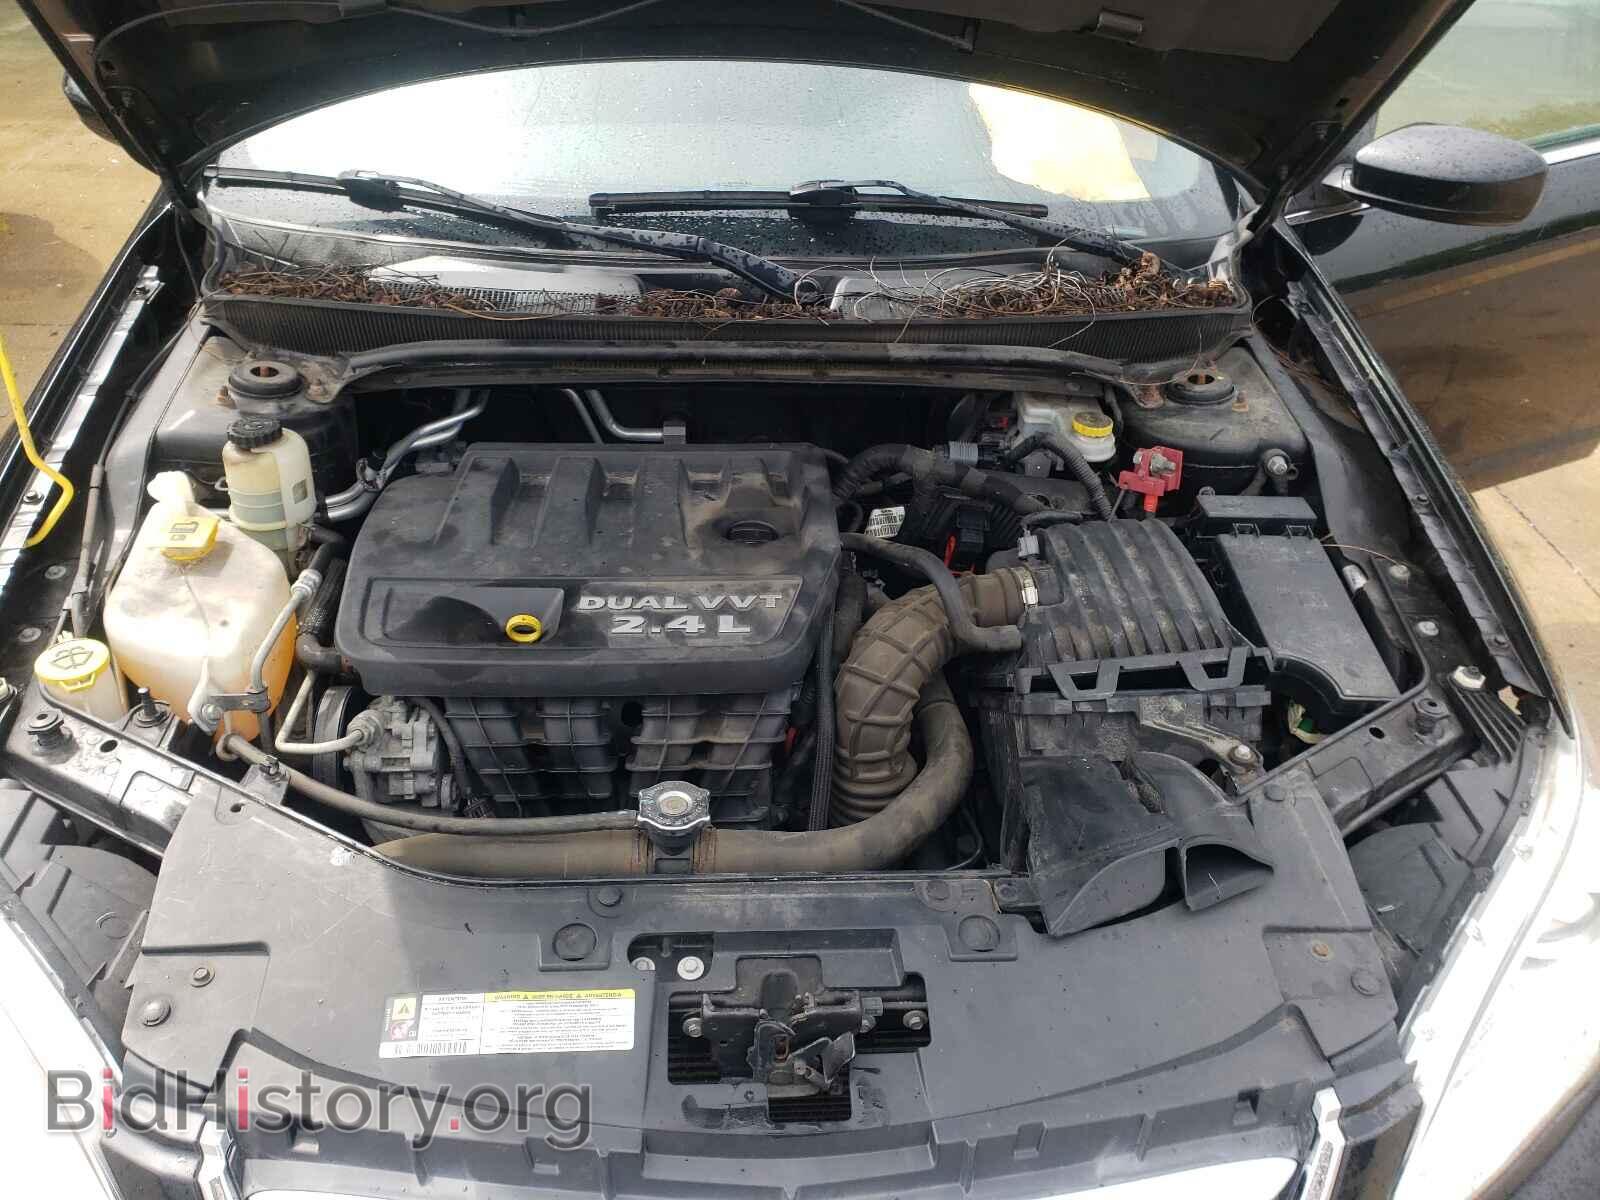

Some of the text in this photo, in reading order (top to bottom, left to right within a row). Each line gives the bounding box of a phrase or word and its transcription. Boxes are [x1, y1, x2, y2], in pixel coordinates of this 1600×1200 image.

[577, 594, 783, 610] DUAL VVT
[611, 614, 751, 634] 2.4 L
